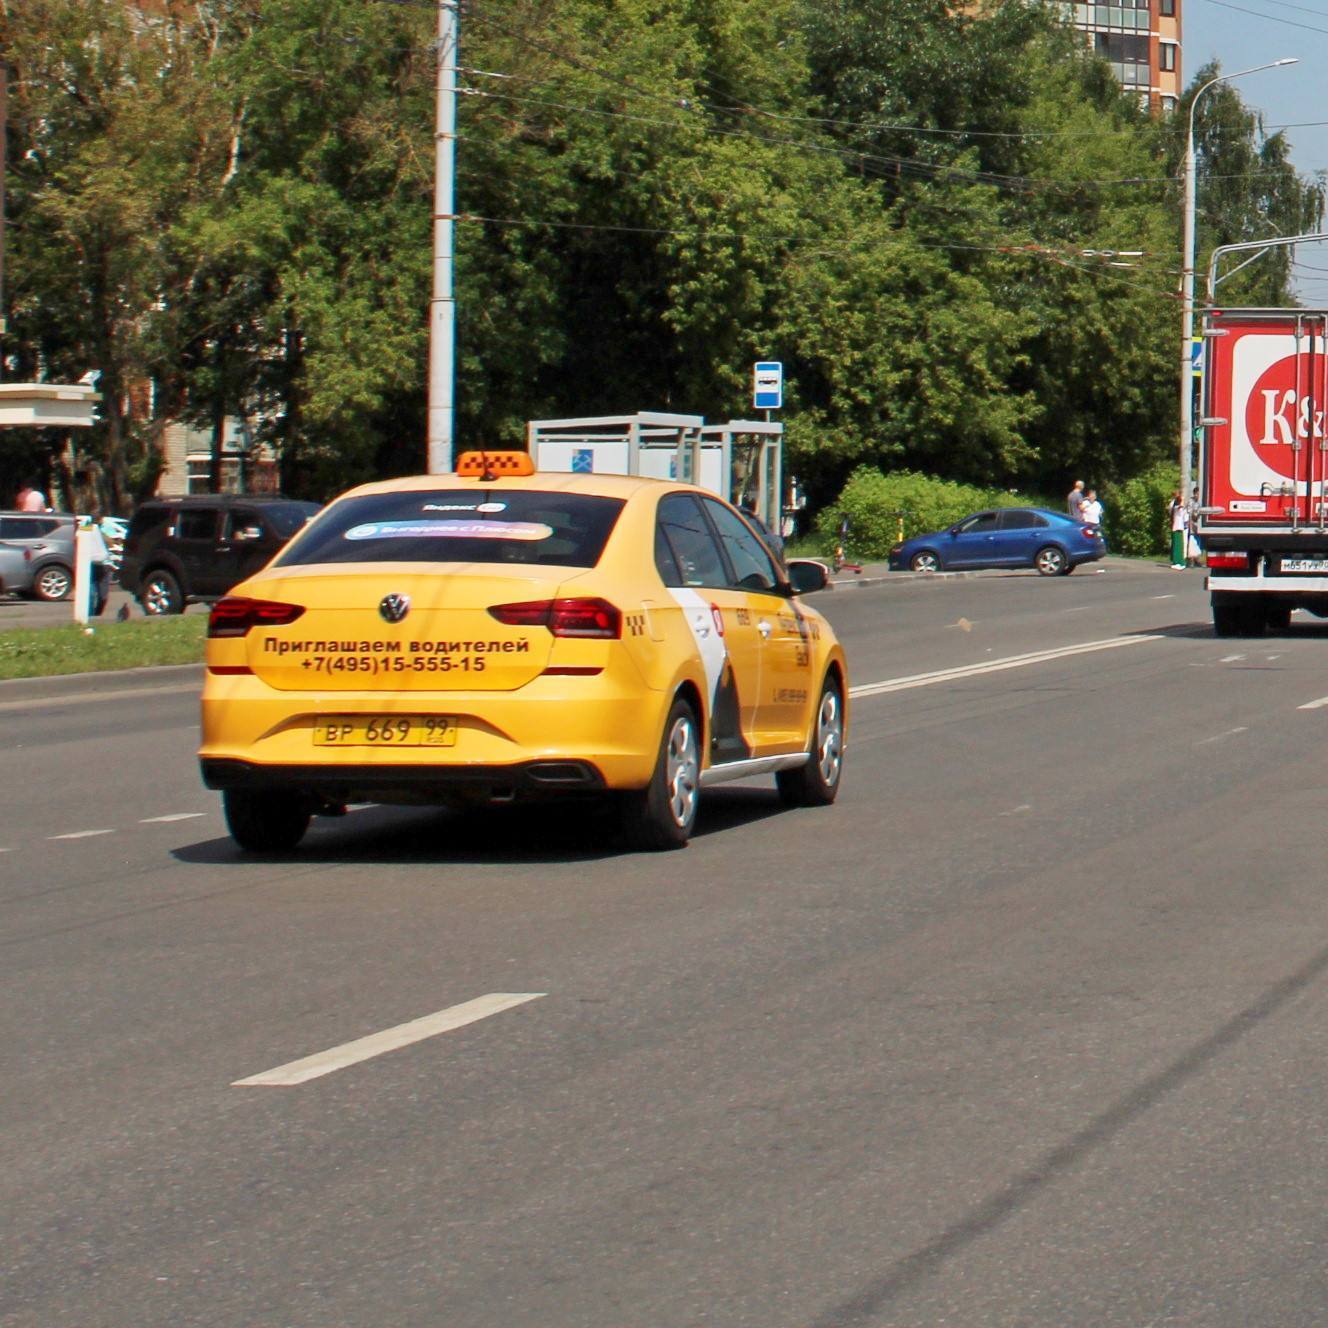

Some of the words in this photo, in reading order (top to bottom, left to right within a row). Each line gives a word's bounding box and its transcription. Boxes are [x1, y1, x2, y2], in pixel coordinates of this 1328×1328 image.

[264, 637, 400, 654] Приглашаем
[409, 637, 529, 654] водителей
[301, 656, 486, 675] +7(495)15-555-15
[365, 719, 411, 742] 669
[425, 719, 449, 736] 99
